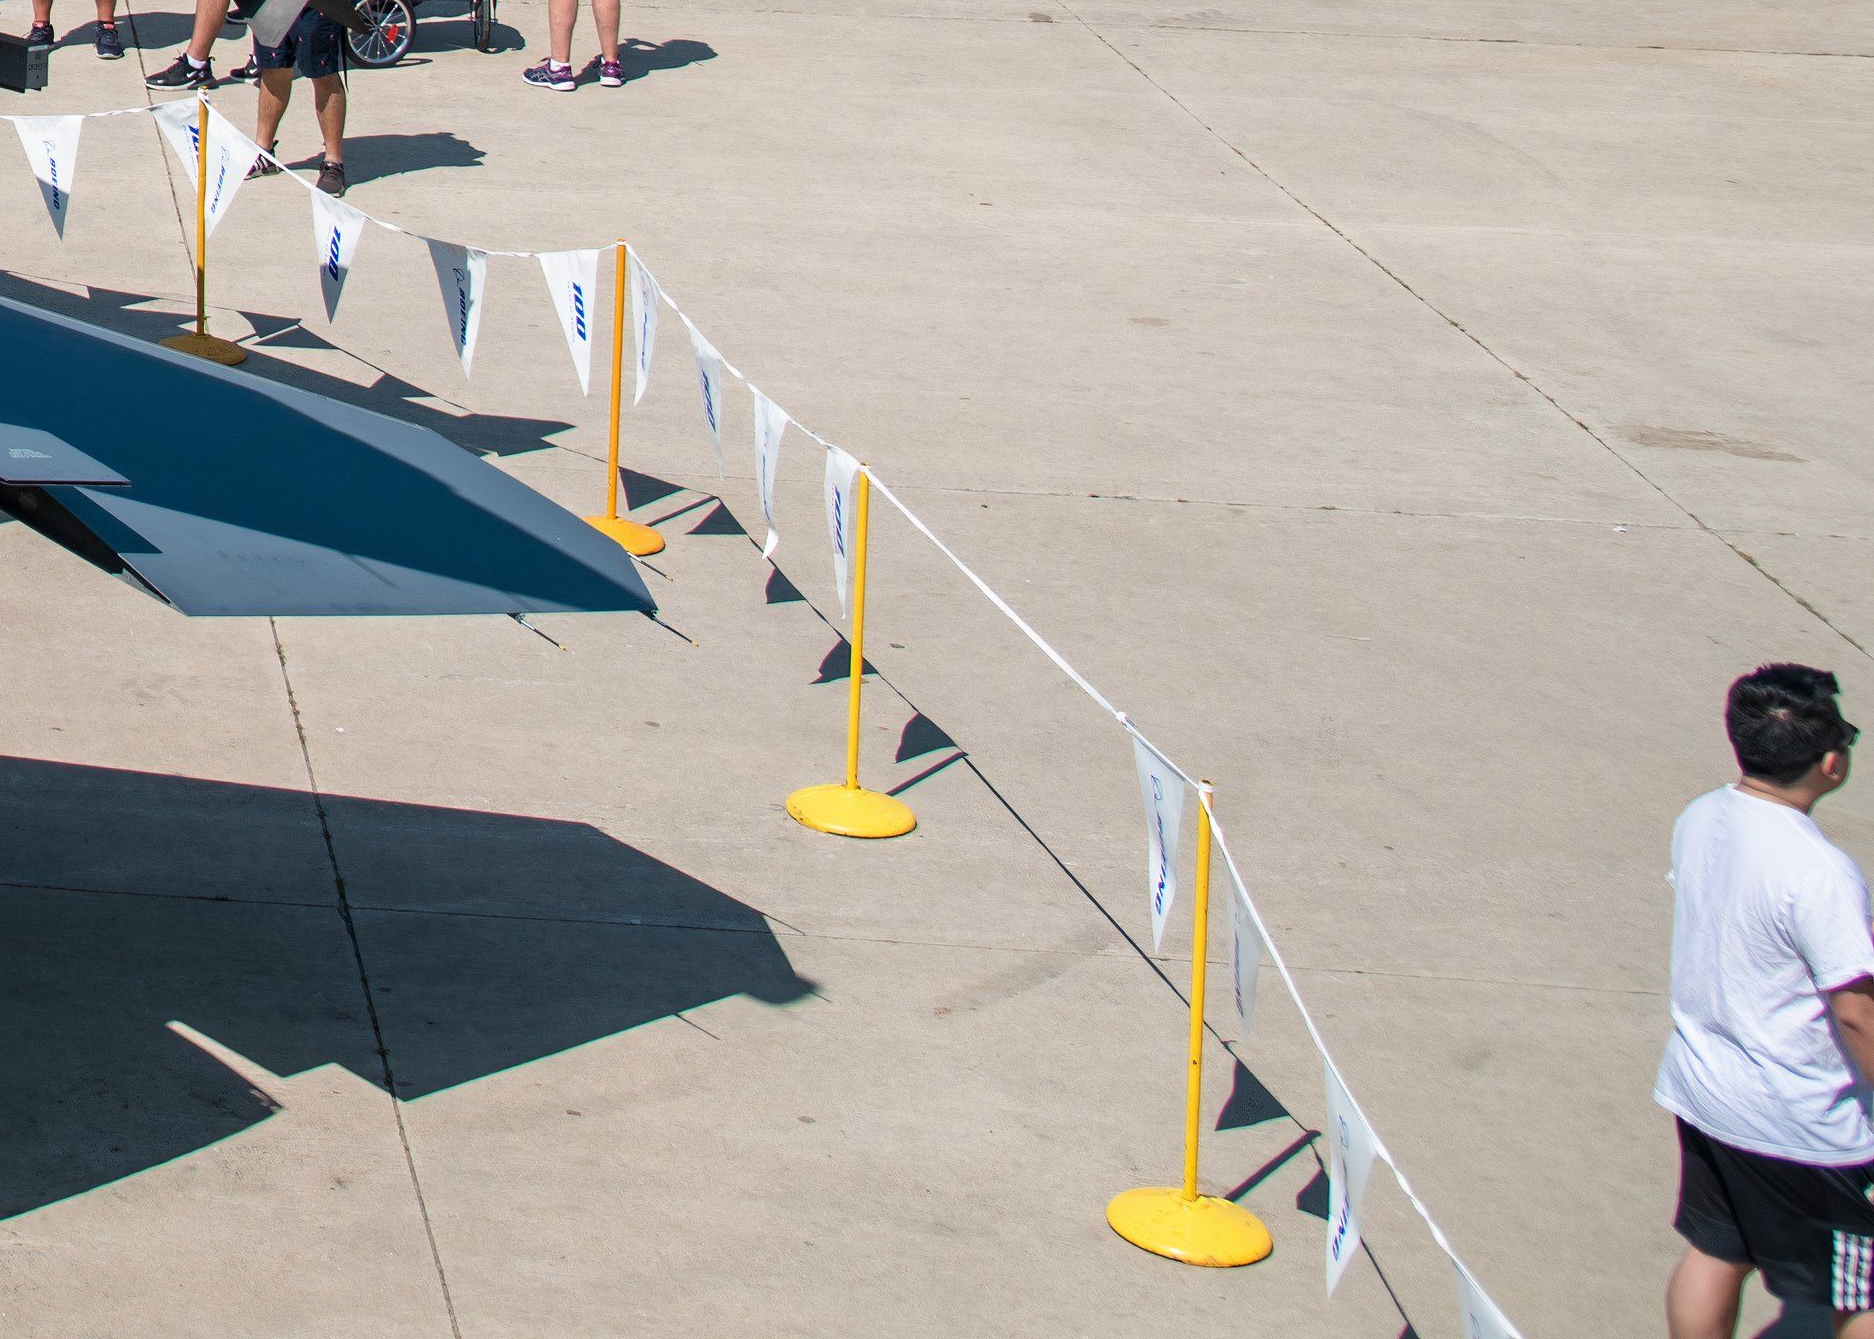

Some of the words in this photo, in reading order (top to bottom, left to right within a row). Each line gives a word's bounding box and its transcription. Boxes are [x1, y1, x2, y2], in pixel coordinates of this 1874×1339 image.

[49, 158, 60, 212] BOEING
[210, 164, 225, 214] BOEING
[329, 225, 342, 283] 100
[460, 287, 468, 347] BOEING
[573, 281, 587, 342] 100
[702, 368, 717, 434] 100
